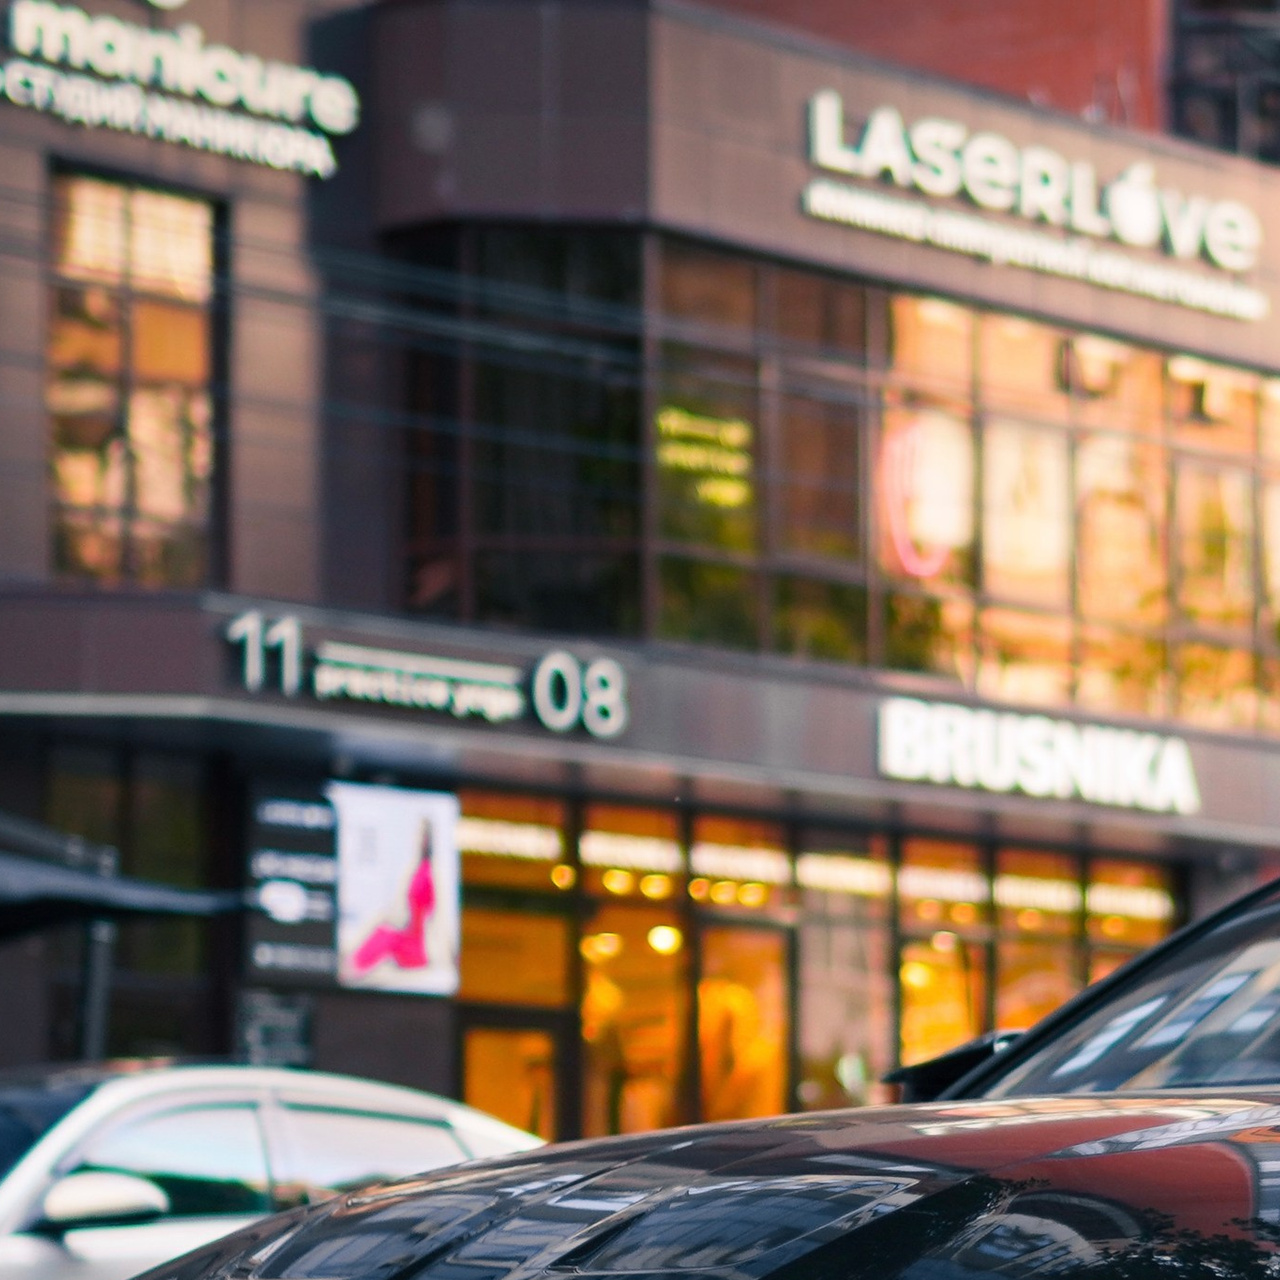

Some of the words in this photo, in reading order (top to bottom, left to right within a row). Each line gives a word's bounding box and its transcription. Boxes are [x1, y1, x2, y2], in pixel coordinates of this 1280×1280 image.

[11, 0, 359, 135] manicure
[227, 609, 300, 697] 11
[533, 650, 629, 738] 08
[878, 696, 1201, 816] BRUSNIKA
